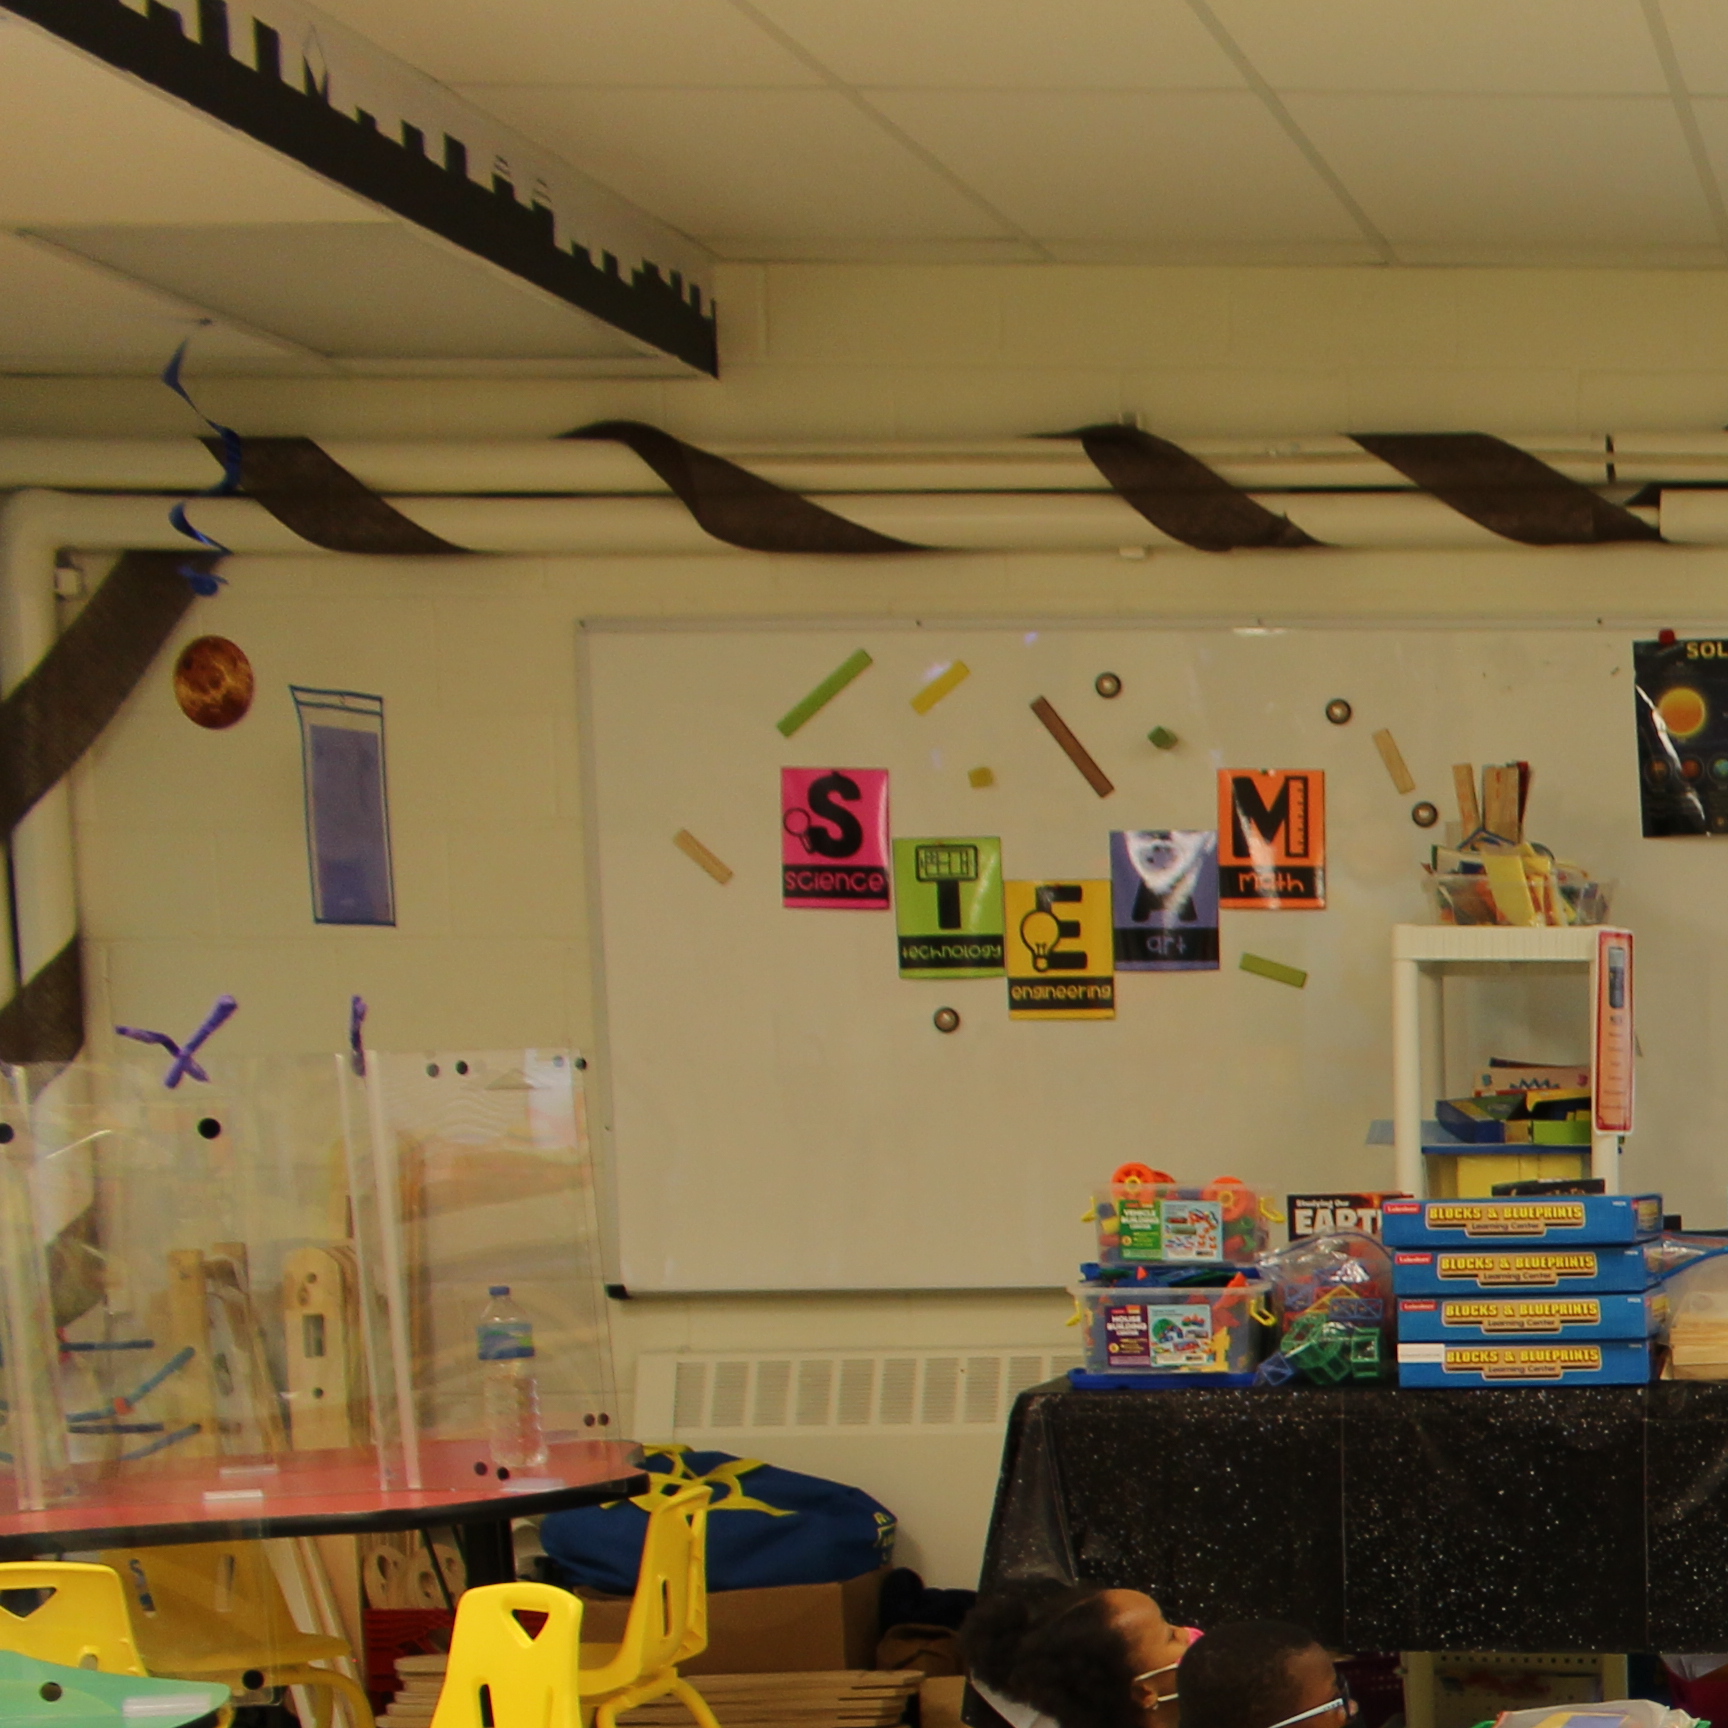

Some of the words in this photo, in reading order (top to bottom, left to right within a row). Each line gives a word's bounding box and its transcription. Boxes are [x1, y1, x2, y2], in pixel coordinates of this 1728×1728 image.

[807, 770, 863, 858] S
[1231, 775, 1309, 858] M
[784, 871, 885, 893] science
[914, 844, 979, 930] T
[1034, 884, 1089, 970] E
[900, 942, 1003, 963] technology
[1146, 934, 1187, 956] art
[1011, 983, 1111, 1002] engineering
[1429, 1207, 1482, 1220] BLOCKS
[1487, 1207, 1498, 1219] &
[1503, 1205, 1583, 1220] BLUEPRINTS
[1472, 1222, 1509, 1232] Learning
[1510, 1222, 1540, 1230] Center
[1441, 1256, 1494, 1270] BLOCKS
[1499, 1256, 1510, 1269] &
[1515, 1254, 1595, 1270] BLUEPRINTS
[1483, 1272, 1521, 1282] Learning
[1522, 1272, 1552, 1280] Center
[1446, 1303, 1497, 1317] BLOCKS
[1503, 1303, 1514, 1316] &
[1519, 1302, 1597, 1317] BLUEPRINTS
[1487, 1318, 1525, 1328] Learning
[1526, 1318, 1555, 1327] Center
[1446, 1350, 1498, 1363] BLOCKS
[1504, 1350, 1515, 1363] &
[1520, 1348, 1598, 1363] BLUEPRINTS
[1488, 1365, 1526, 1375] Learning
[1527, 1364, 1556, 1373] Center
